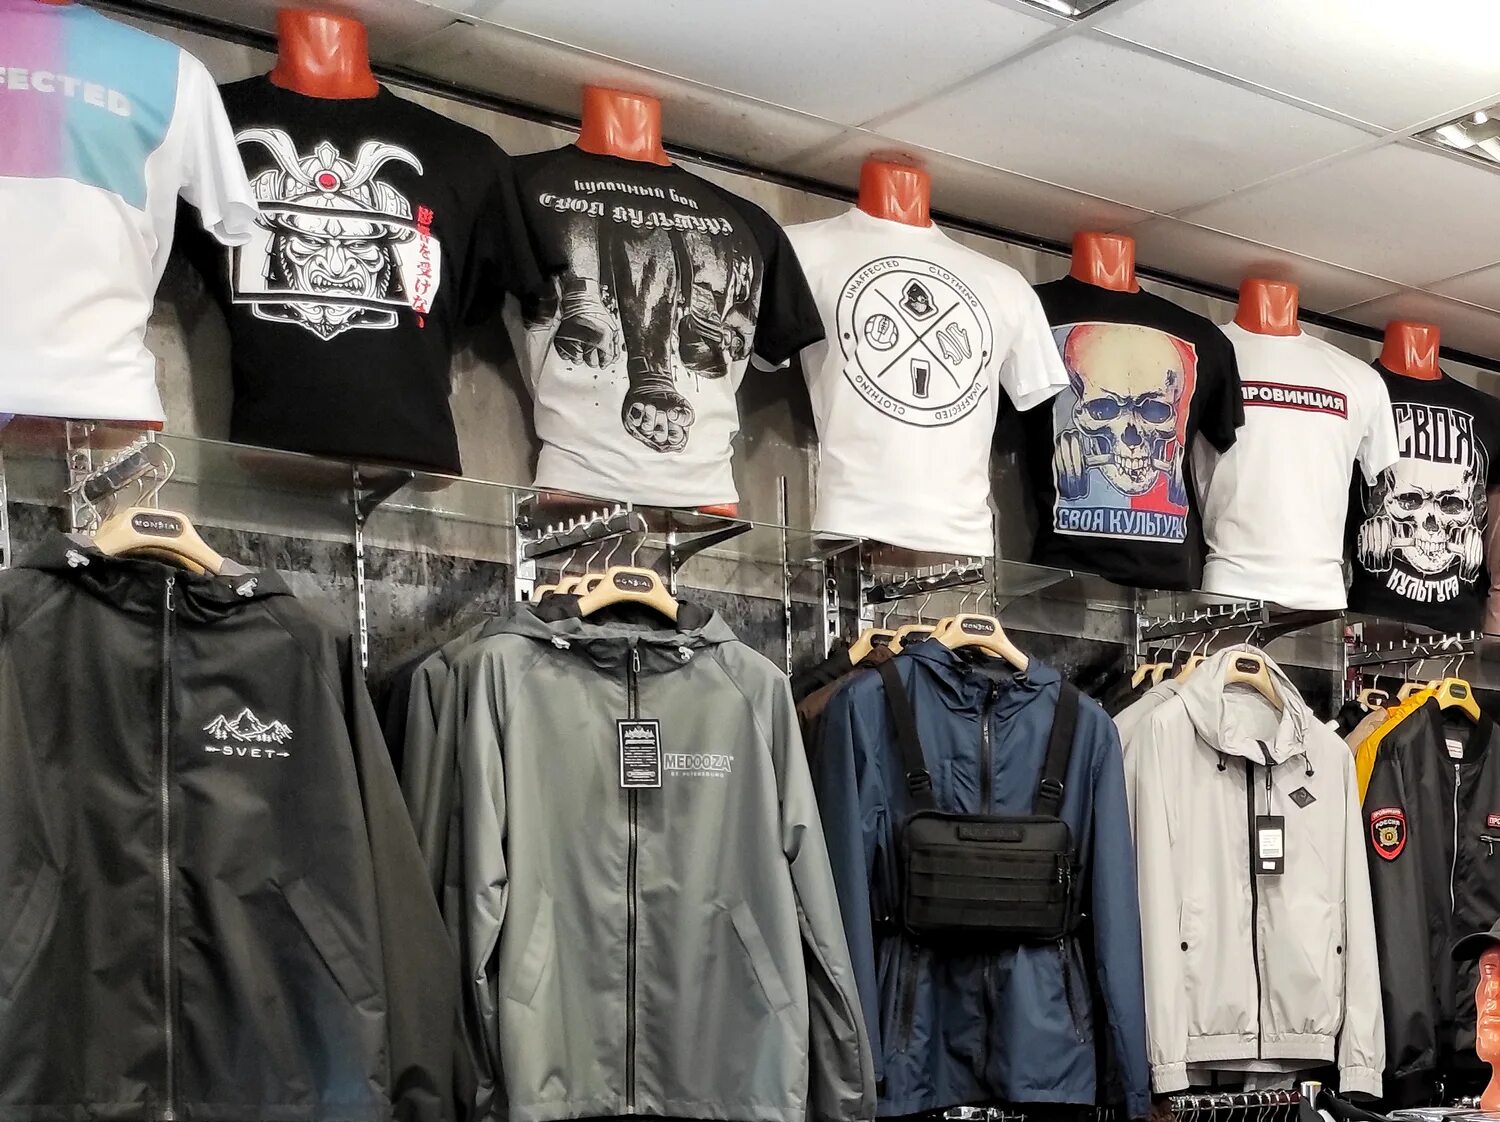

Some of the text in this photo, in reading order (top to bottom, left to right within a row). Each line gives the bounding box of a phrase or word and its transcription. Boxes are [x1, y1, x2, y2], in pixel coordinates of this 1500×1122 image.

[0, 66, 131, 117] ECTED
[845, 260, 978, 308] UNAFFECTED CLOTHING
[855, 374, 906, 416] CLOTHING
[934, 382, 982, 421] UNAFFECTED
[1391, 402, 1475, 468] СВОЯ
[1058, 508, 1185, 538] СВОЯ КУЛЬТУРА
[1386, 567, 1460, 604] КУЛЬТУРА
[222, 746, 276, 759] SVET
[663, 753, 732, 773] MEDOOZA
